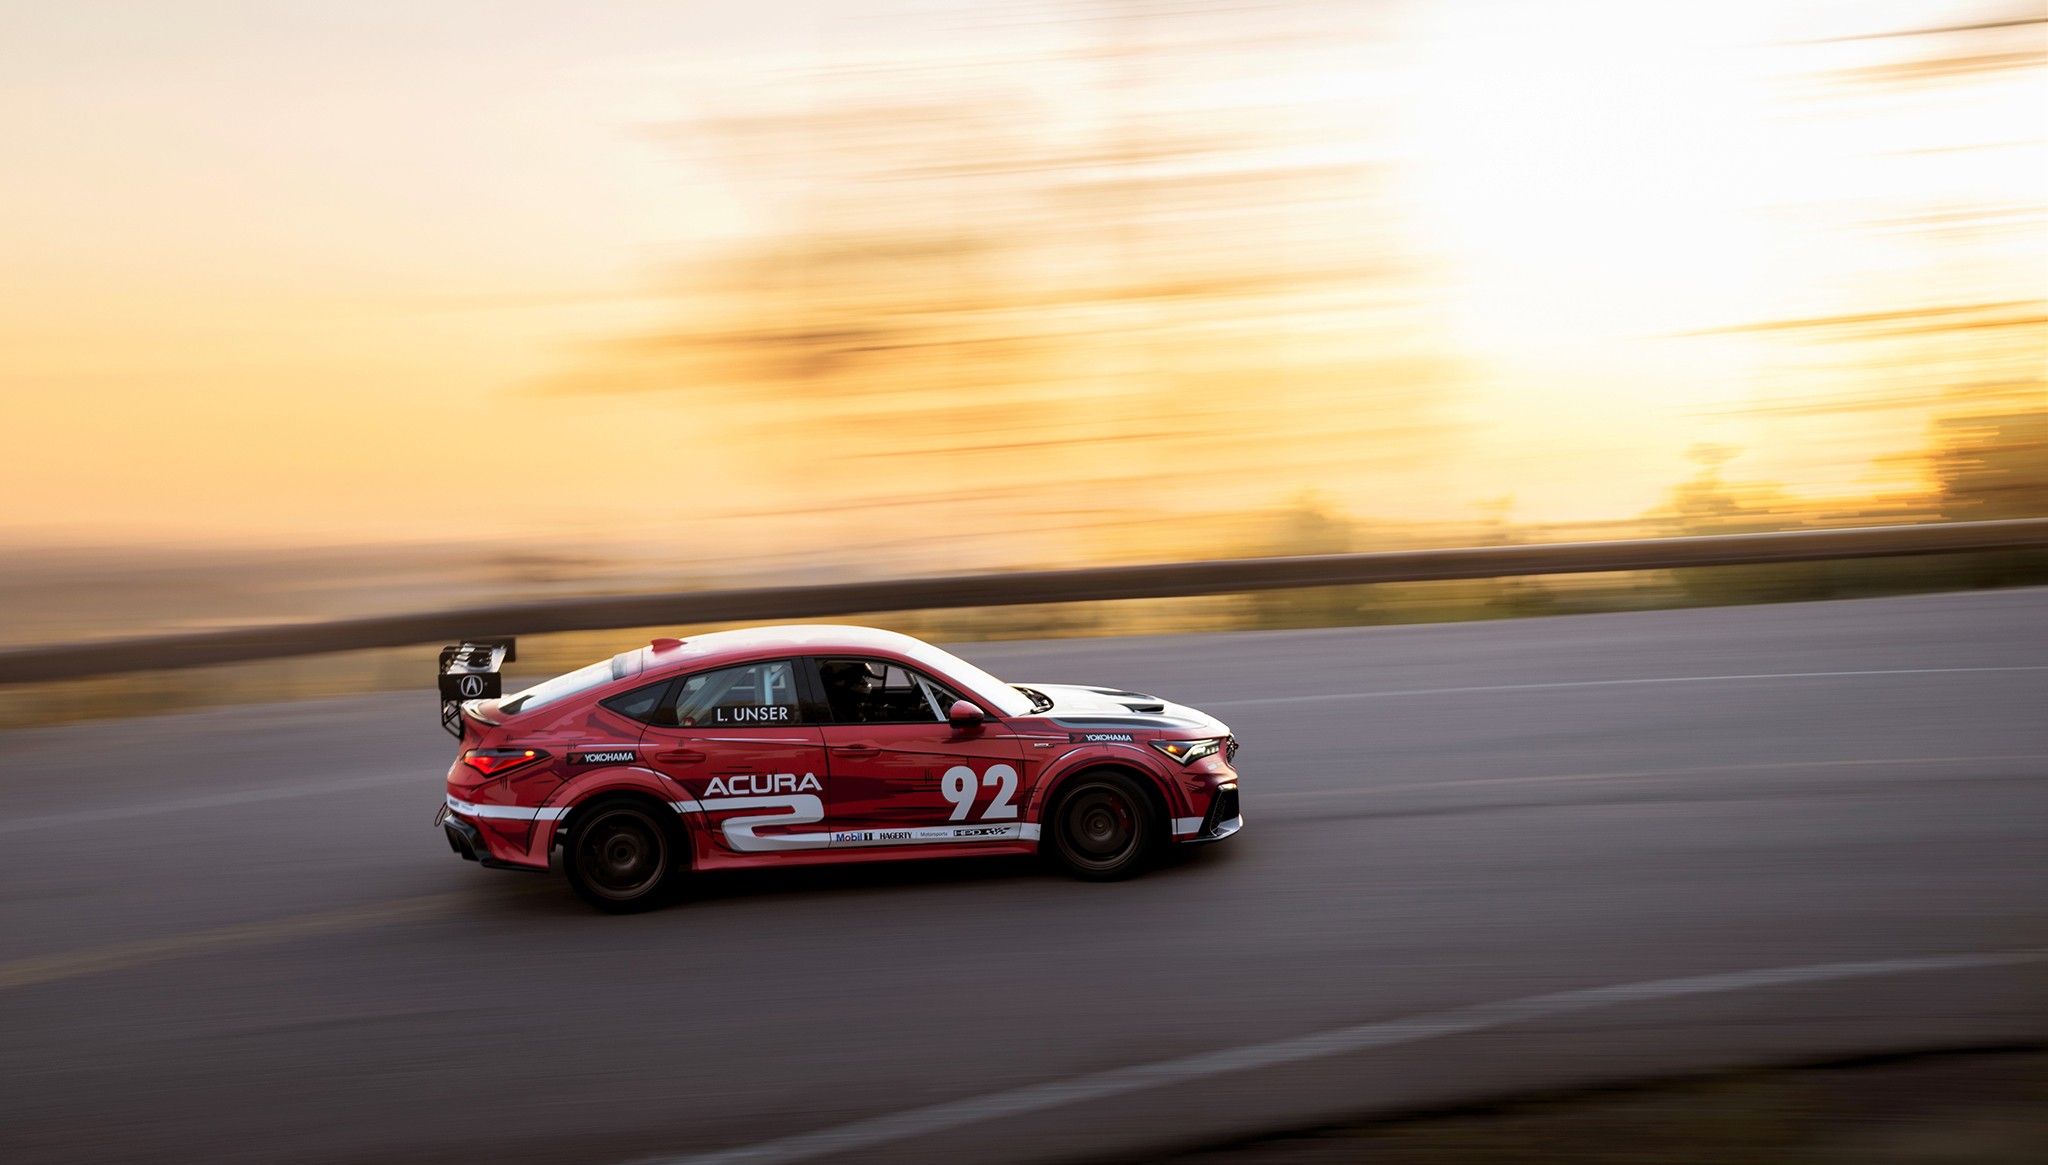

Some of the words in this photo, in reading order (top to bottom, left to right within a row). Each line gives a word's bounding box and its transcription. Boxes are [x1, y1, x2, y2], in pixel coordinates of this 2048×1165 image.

[717, 708, 728, 722] L.
[734, 707, 789, 721] UNSER
[1085, 734, 1133, 742] YOKOHAMA
[584, 752, 634, 763] YOKOHAMA
[703, 772, 823, 797] ACURA
[941, 763, 1018, 821] 92
[836, 832, 862, 842] Mobil
[879, 831, 912, 840] HAGERTY
